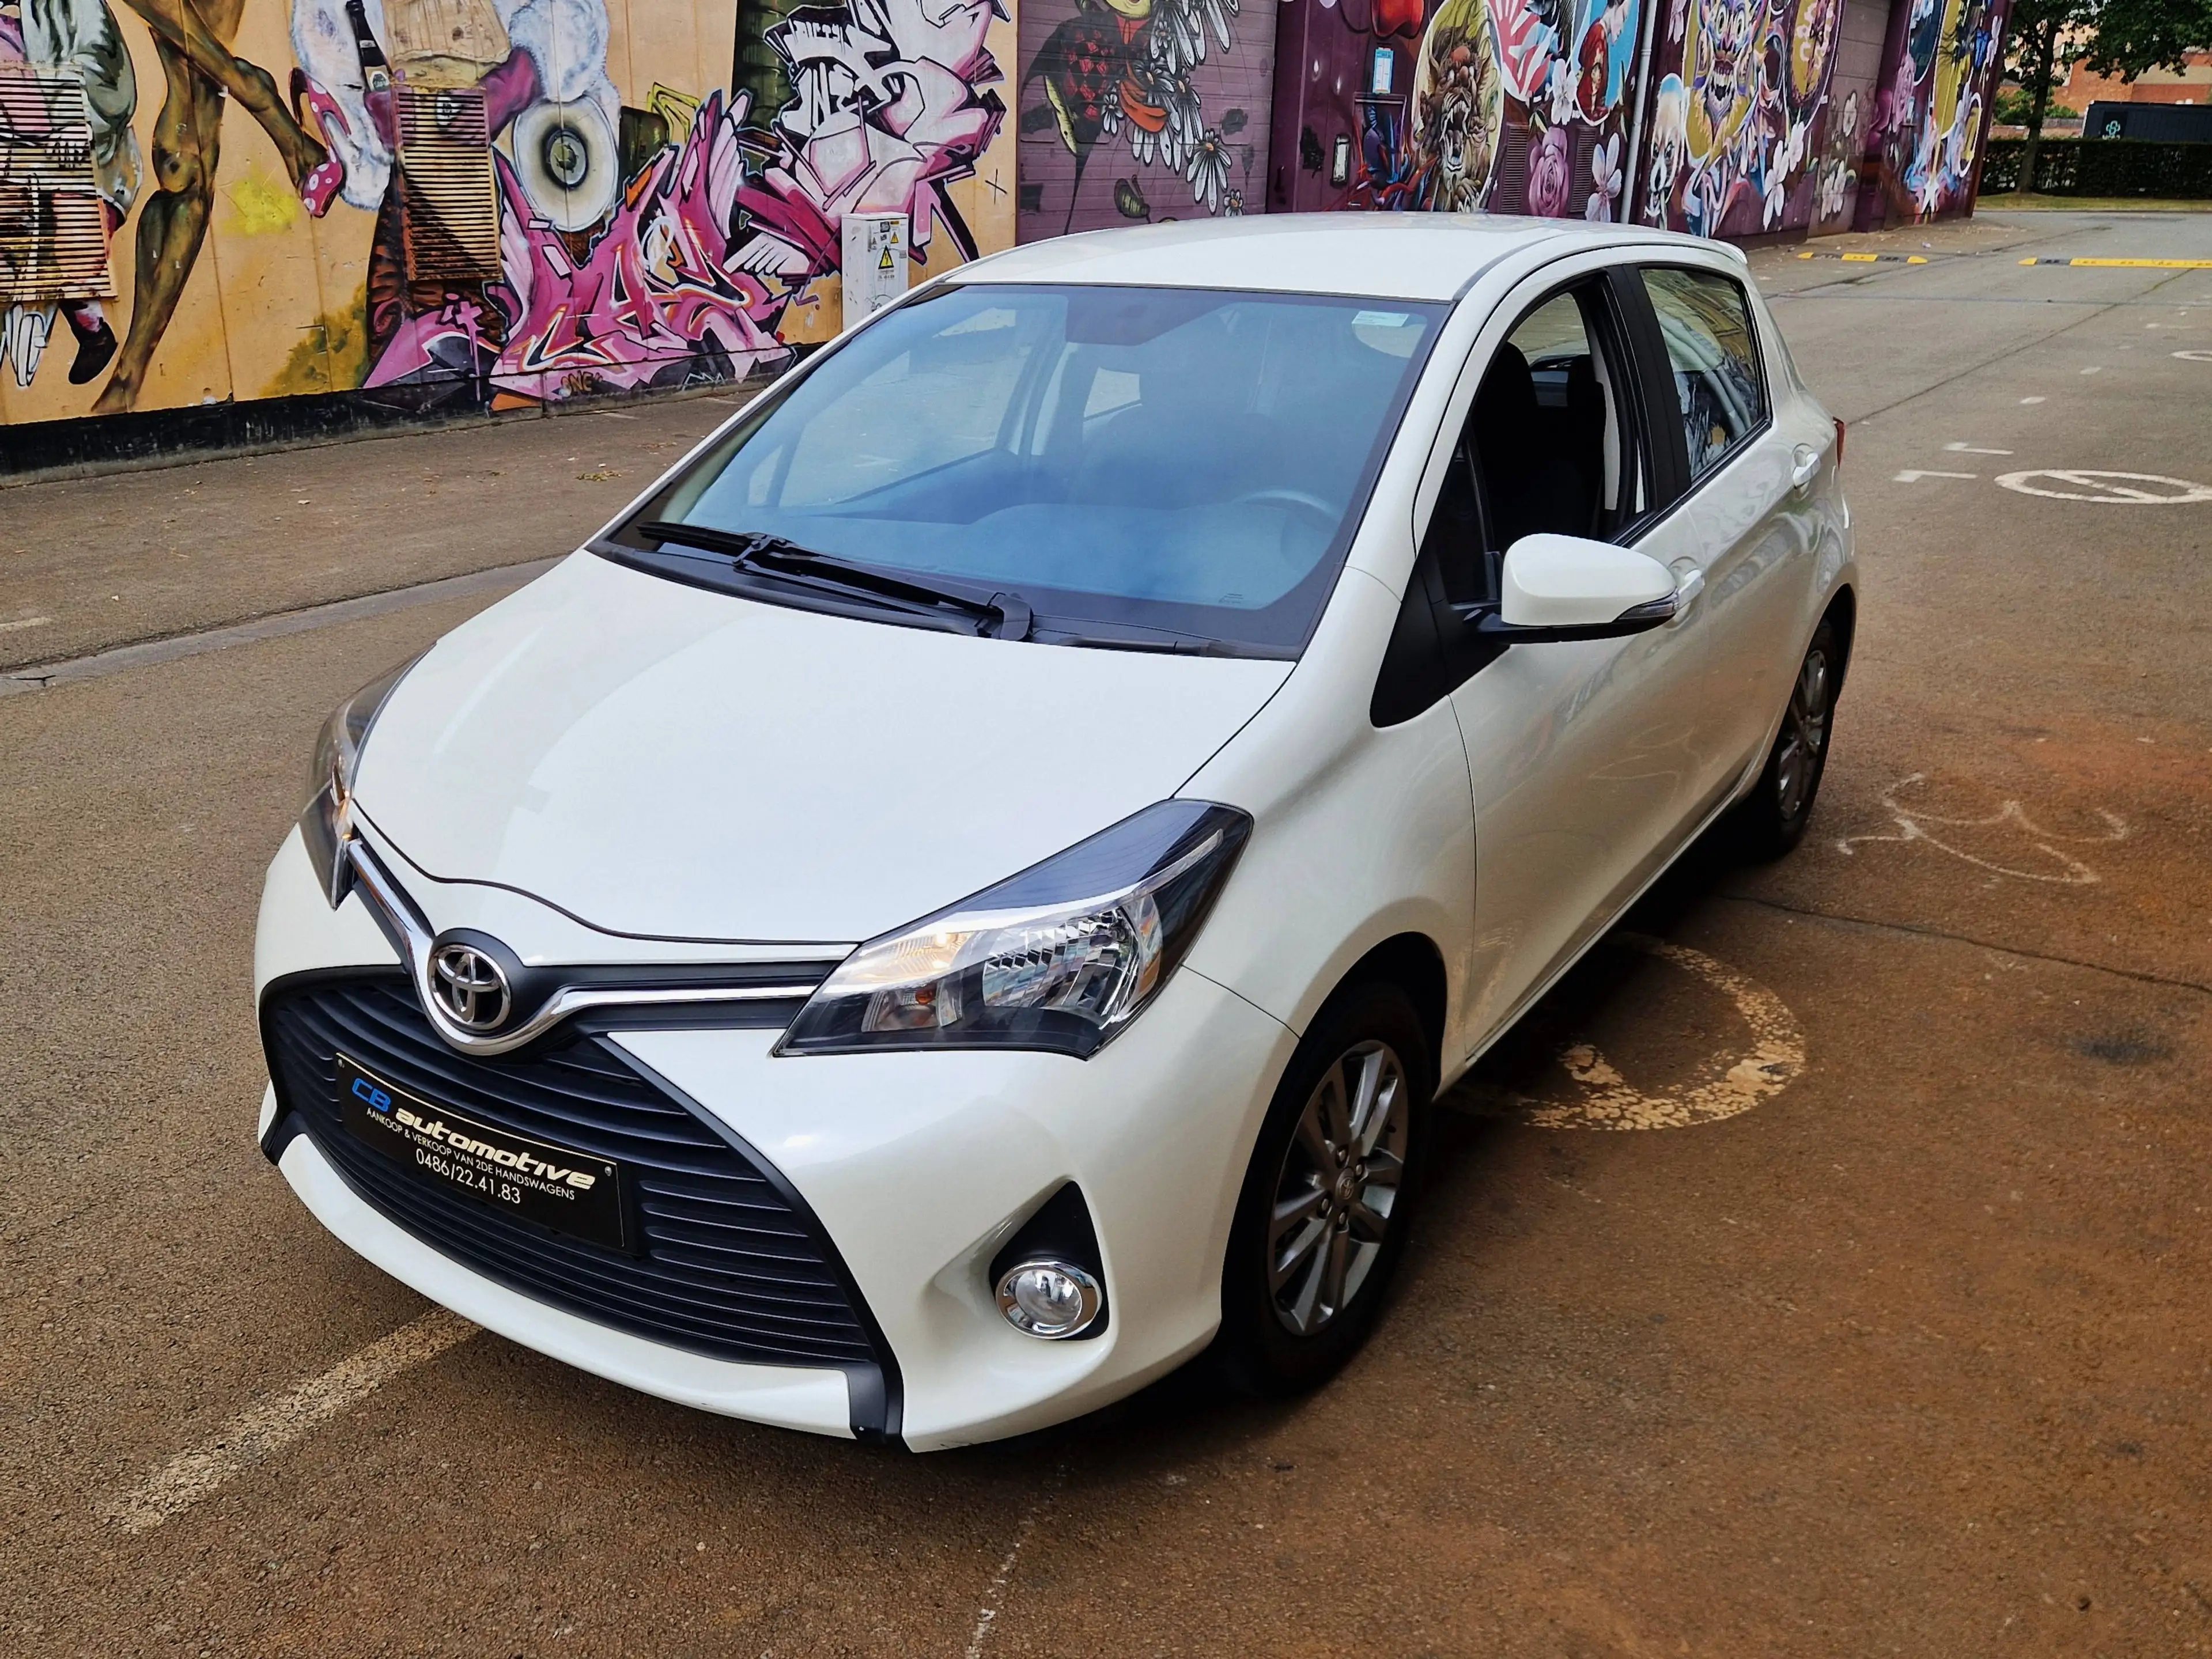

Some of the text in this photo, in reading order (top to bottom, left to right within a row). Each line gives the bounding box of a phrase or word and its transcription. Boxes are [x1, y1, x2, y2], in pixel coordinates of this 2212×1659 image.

[352, 1078, 596, 1190] CB automotive
[366, 1107, 575, 1200] AANKOOP & VERKOOP VAN 2DE HANDSWAGENS
[416, 1148, 521, 1204] 0486/22.41.83
